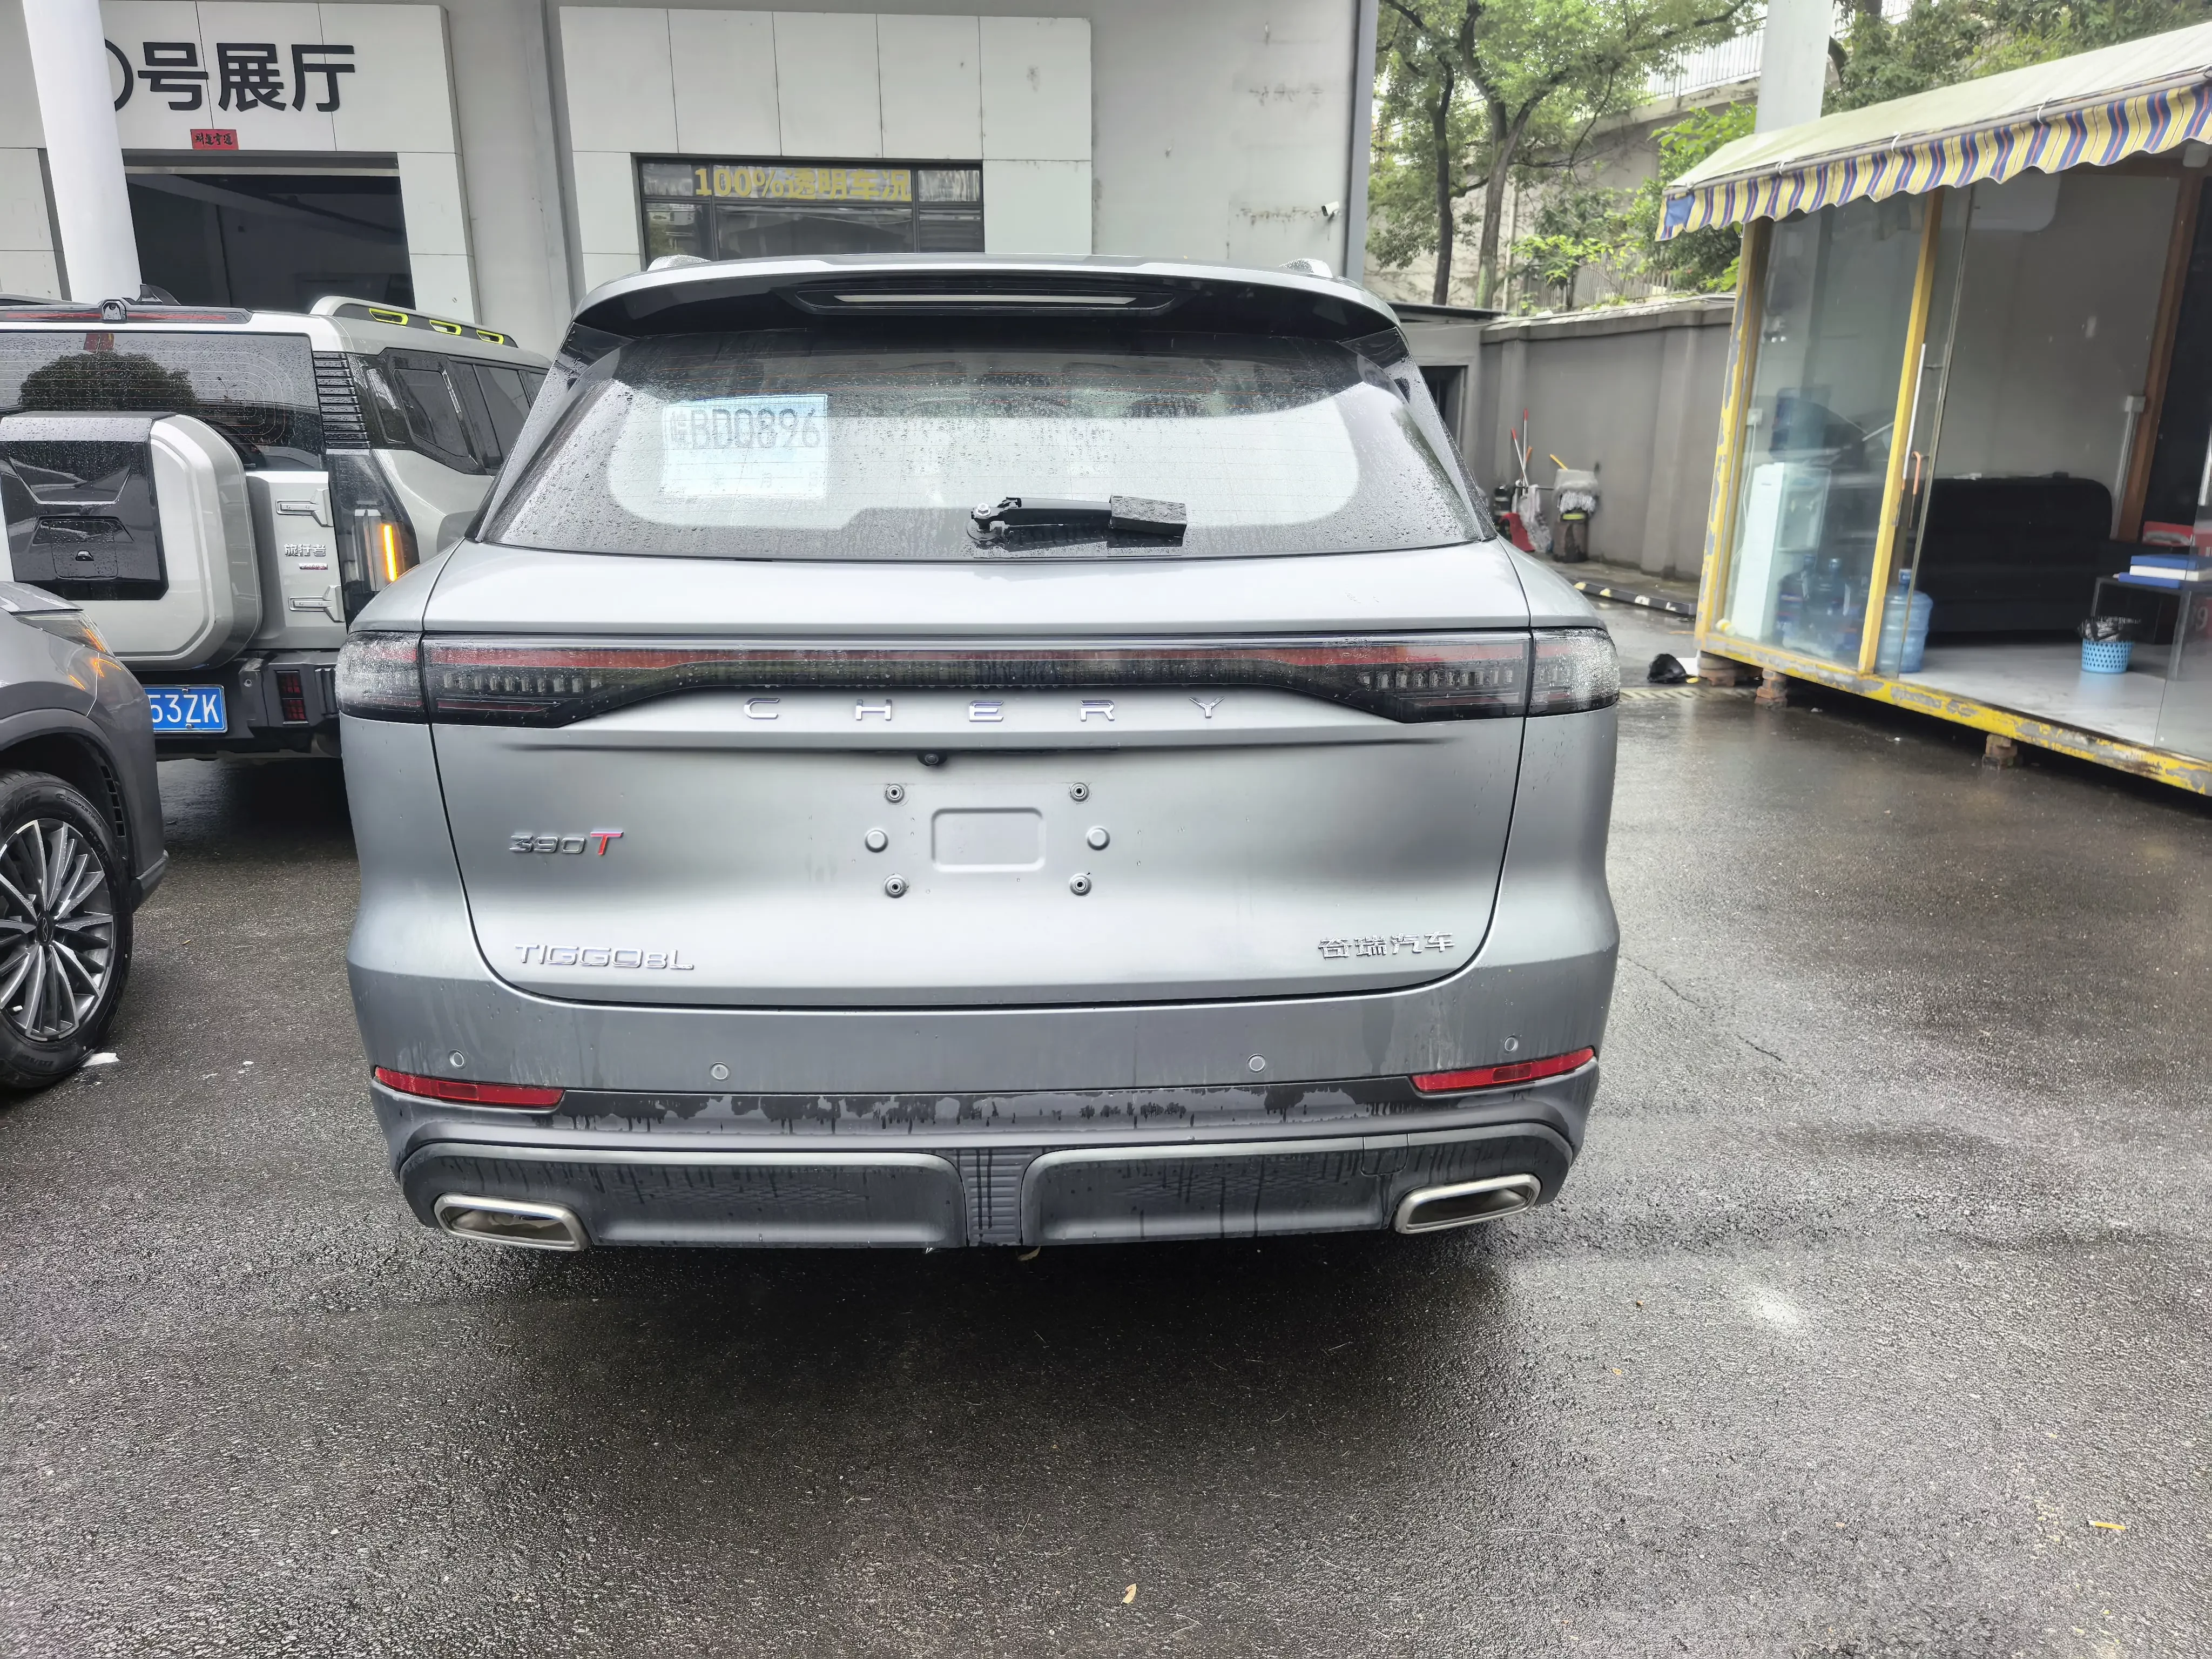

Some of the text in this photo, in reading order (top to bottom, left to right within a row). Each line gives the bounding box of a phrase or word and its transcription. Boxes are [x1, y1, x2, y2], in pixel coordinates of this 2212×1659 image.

[695, 167, 913, 201] 100%透明车况
[284, 543, 326, 557] 旅行者
[744, 697, 1225, 722] CHERY
[509, 831, 624, 856] 390T
[1318, 931, 1455, 959] 奇瑞汽车
